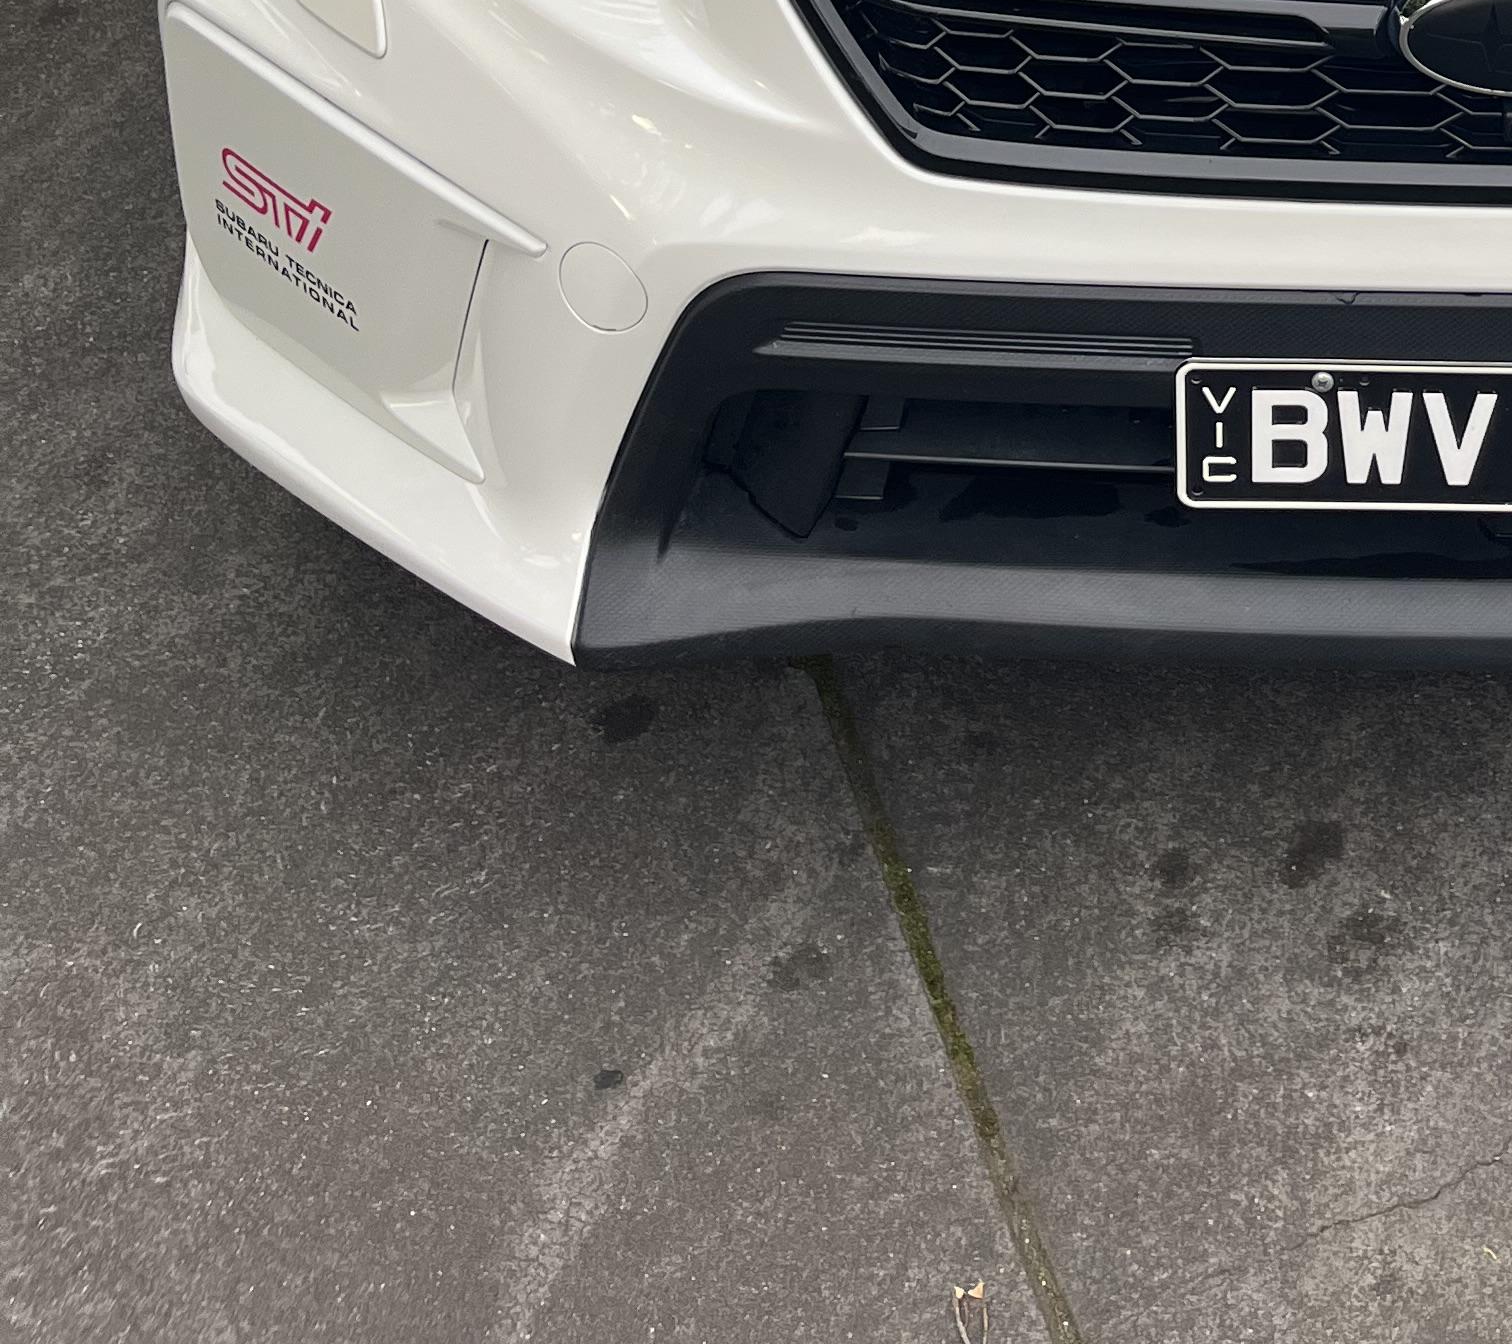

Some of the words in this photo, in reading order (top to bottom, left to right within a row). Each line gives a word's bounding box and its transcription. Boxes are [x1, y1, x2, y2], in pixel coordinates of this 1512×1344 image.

[215, 198, 279, 257] SUBARU
[285, 254, 357, 316] TECNICA
[217, 213, 360, 332] INTERNATIONAL
[1251, 388, 1499, 487] BWV
